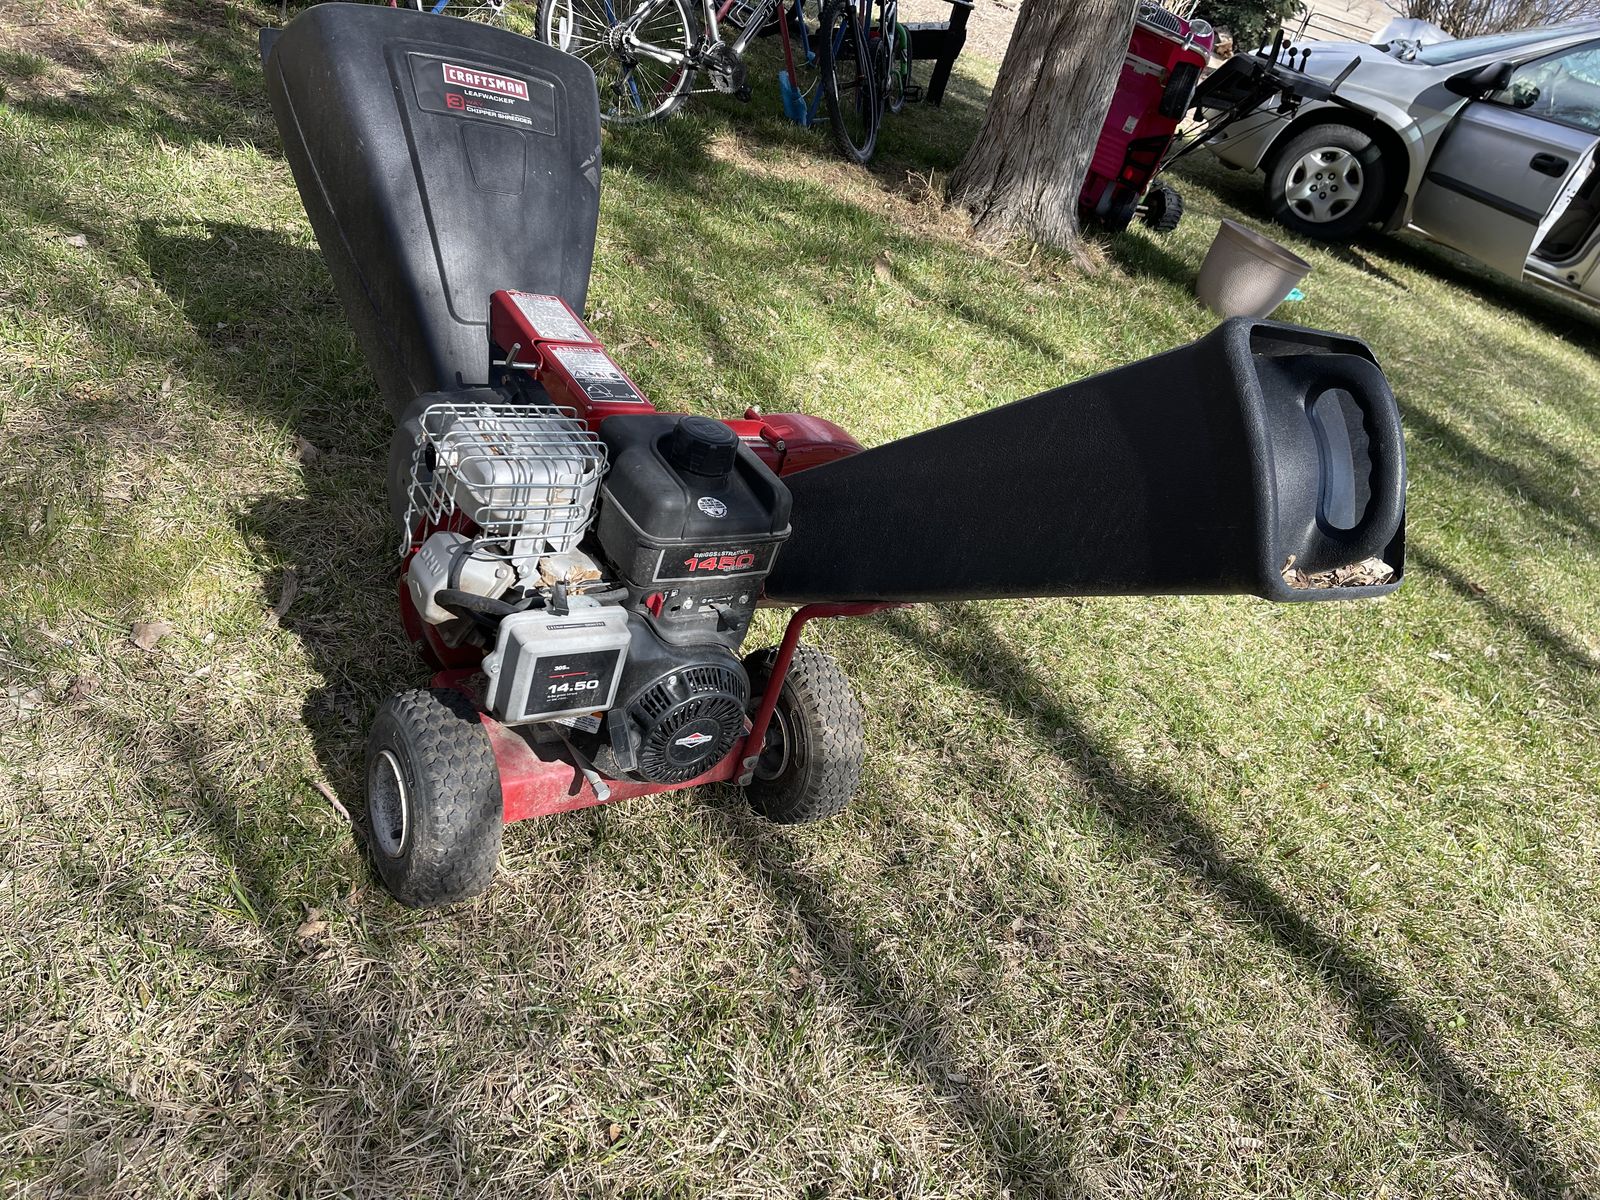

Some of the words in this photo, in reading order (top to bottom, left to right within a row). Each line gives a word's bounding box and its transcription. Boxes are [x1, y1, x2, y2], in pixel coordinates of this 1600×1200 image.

[448, 69, 524, 95] CRAFTSMAN
[447, 94, 464, 108] 3
[464, 89, 514, 105] LEAFWACKER
[466, 106, 497, 118] CHIPPER
[497, 113, 533, 126] SHREDDER
[420, 546, 444, 577] OHV
[684, 554, 755, 571] 1450
[547, 679, 600, 693] 14.50
